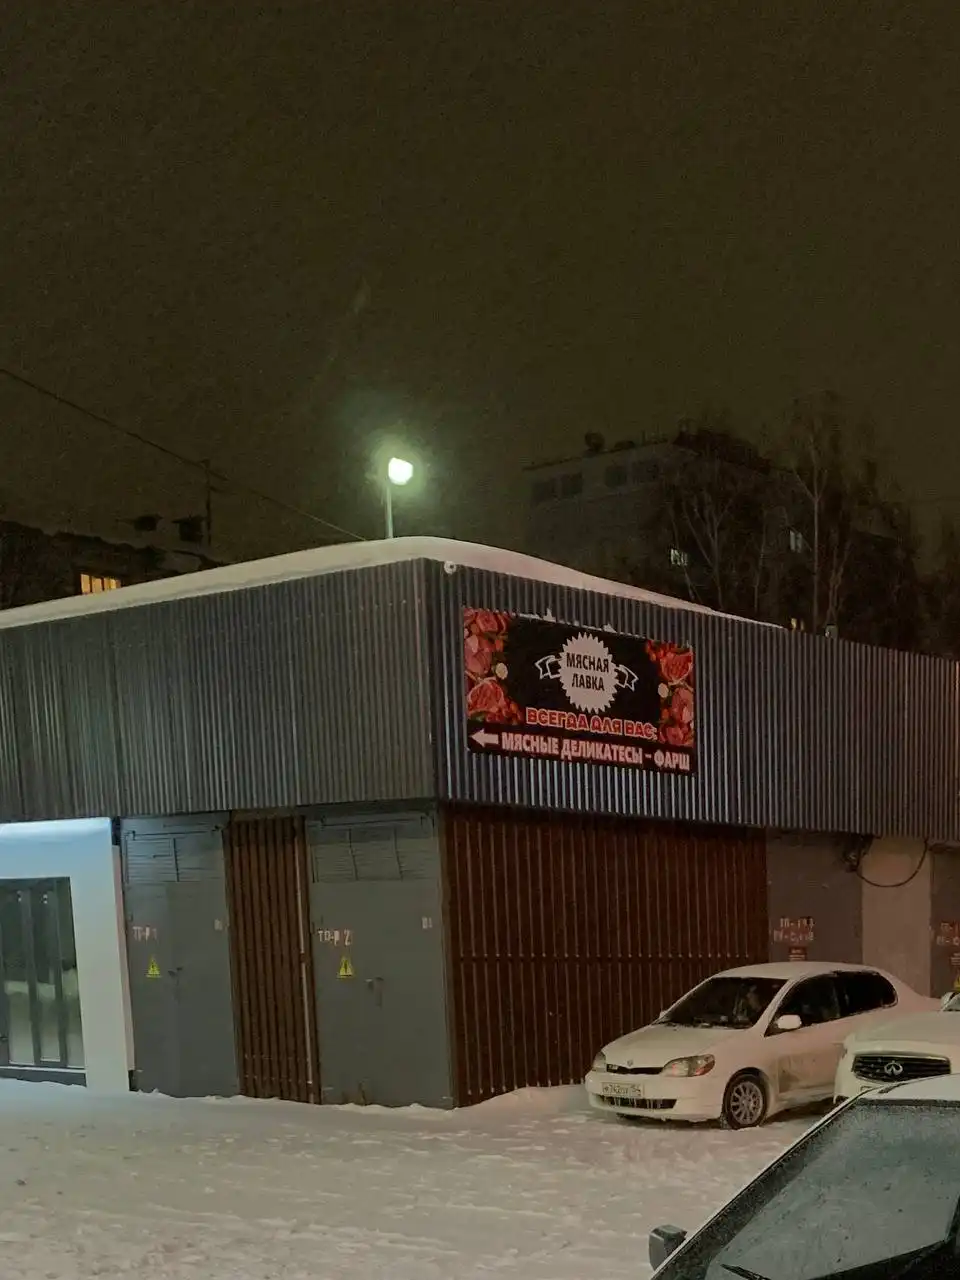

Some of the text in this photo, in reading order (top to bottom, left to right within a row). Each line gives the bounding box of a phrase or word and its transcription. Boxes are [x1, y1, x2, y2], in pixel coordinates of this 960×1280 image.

[566, 653, 609, 673] МЯСНАЯ
[571, 675, 605, 692] ЛАВКА
[525, 707, 590, 731] ВСЕГДА
[590, 716, 623, 735] ДЛЯ
[501, 731, 560, 755] МЯСНЫЕ
[560, 738, 643, 765] ДЕЛИКАТЕСЫ
[653, 749, 690, 771] ФАРШ
